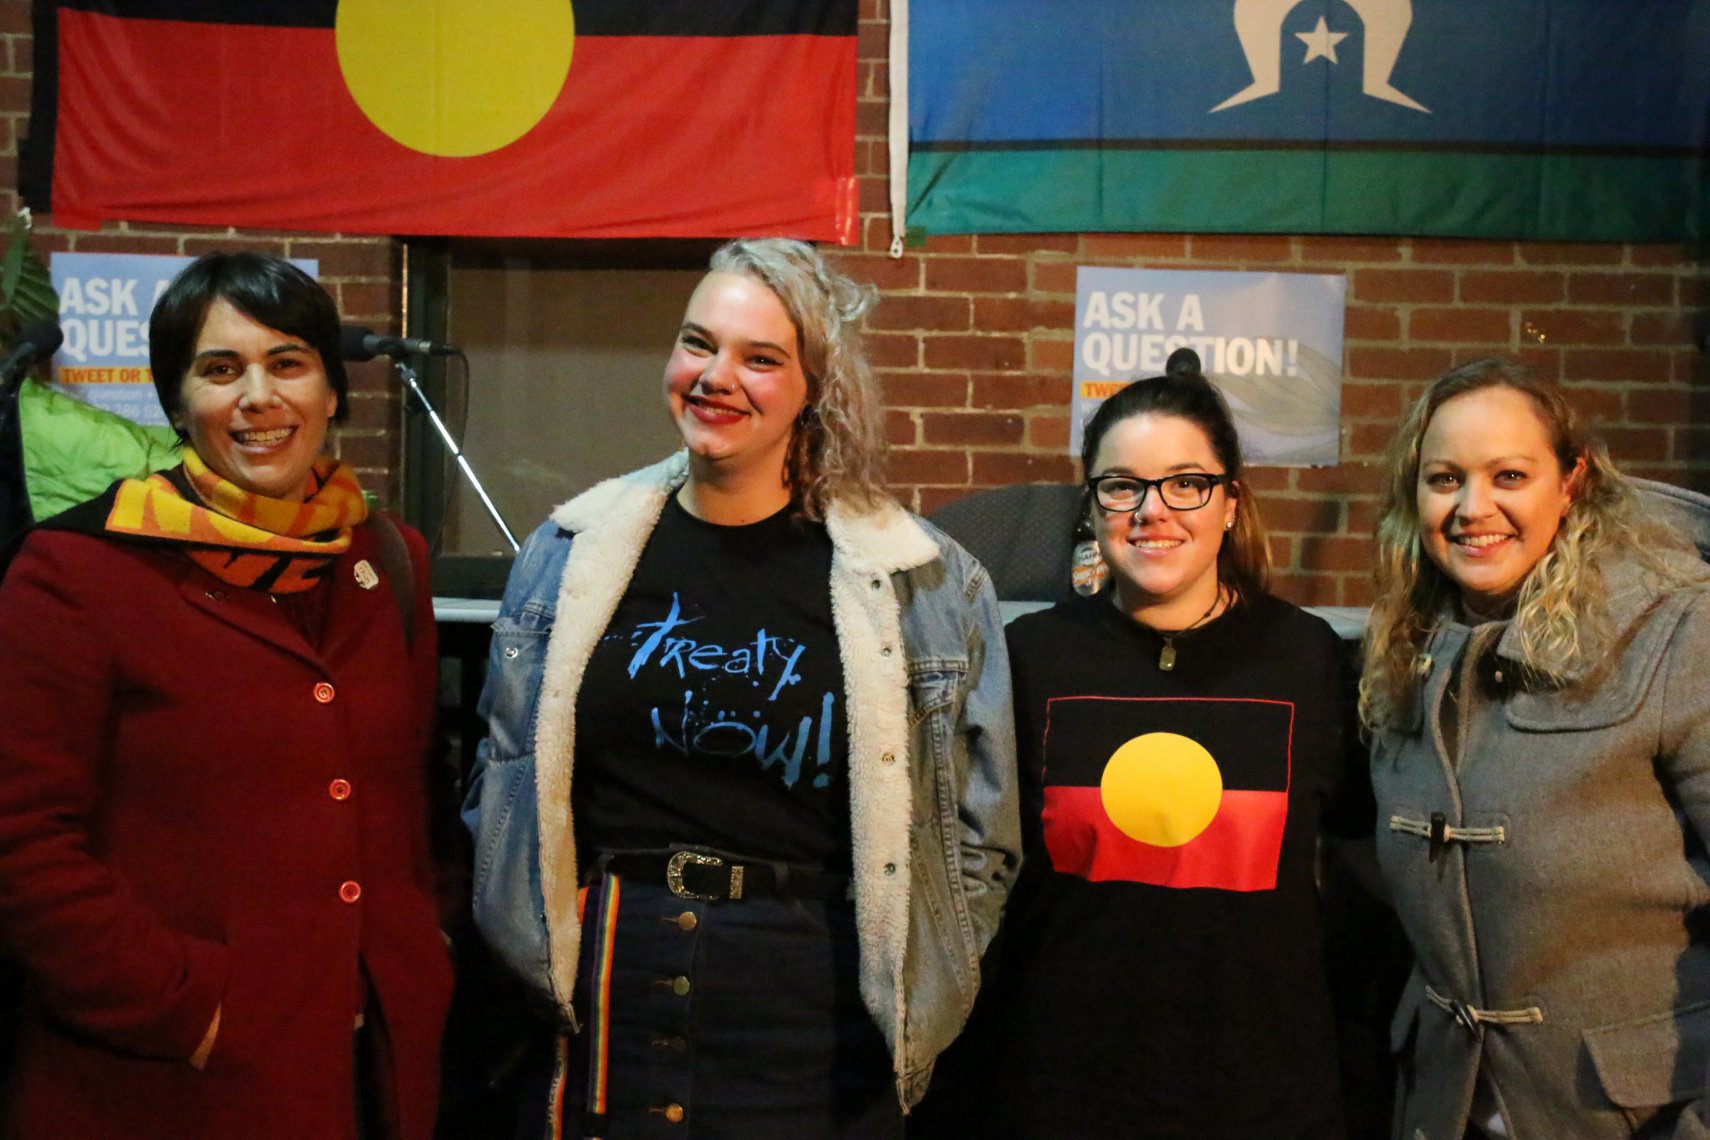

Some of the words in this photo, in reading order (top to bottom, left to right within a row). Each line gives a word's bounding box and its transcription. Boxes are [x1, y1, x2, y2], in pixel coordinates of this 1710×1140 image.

[60, 277, 139, 316] ASK
[1083, 291, 1164, 331] ASK
[1176, 293, 1205, 332] A
[62, 368, 115, 384] TWEET
[119, 368, 142, 384] OR
